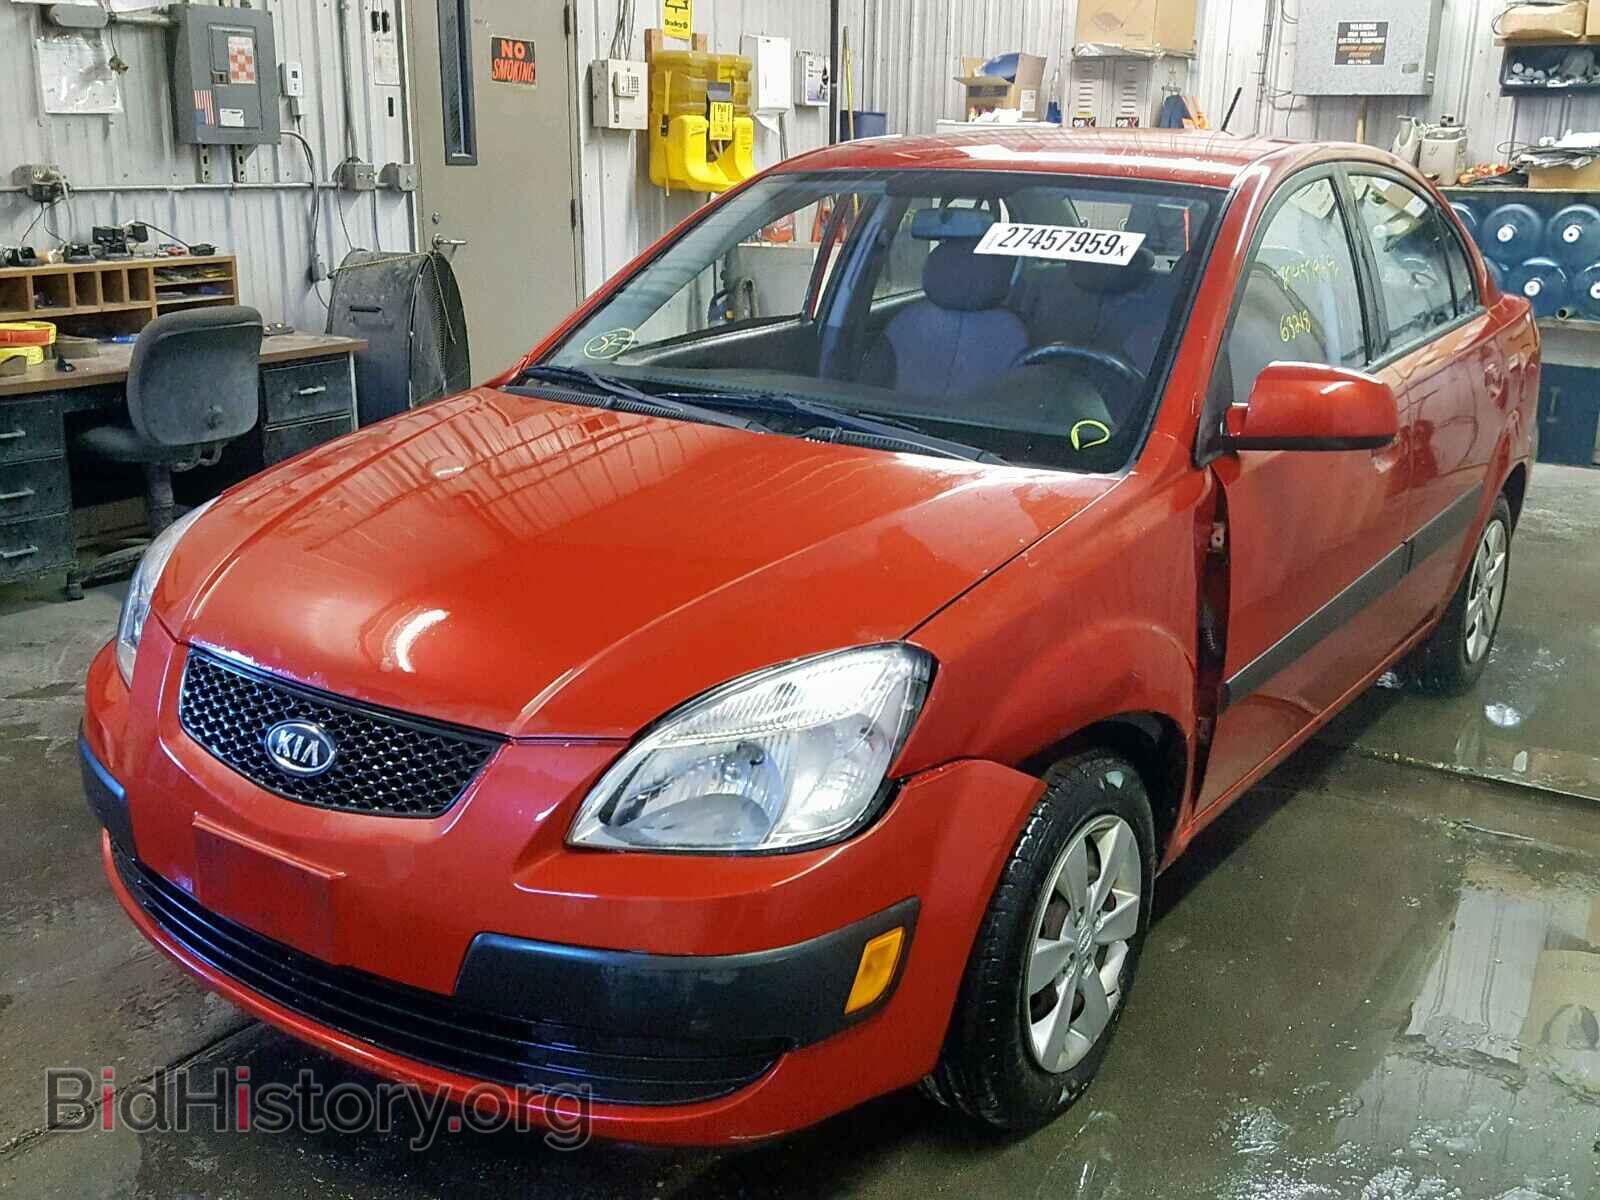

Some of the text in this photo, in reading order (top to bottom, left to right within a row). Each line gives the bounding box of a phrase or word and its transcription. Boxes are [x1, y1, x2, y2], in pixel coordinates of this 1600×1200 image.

[501, 40, 526, 60] NO
[492, 59, 535, 82] SMOKING
[275, 729, 320, 767] KIA
